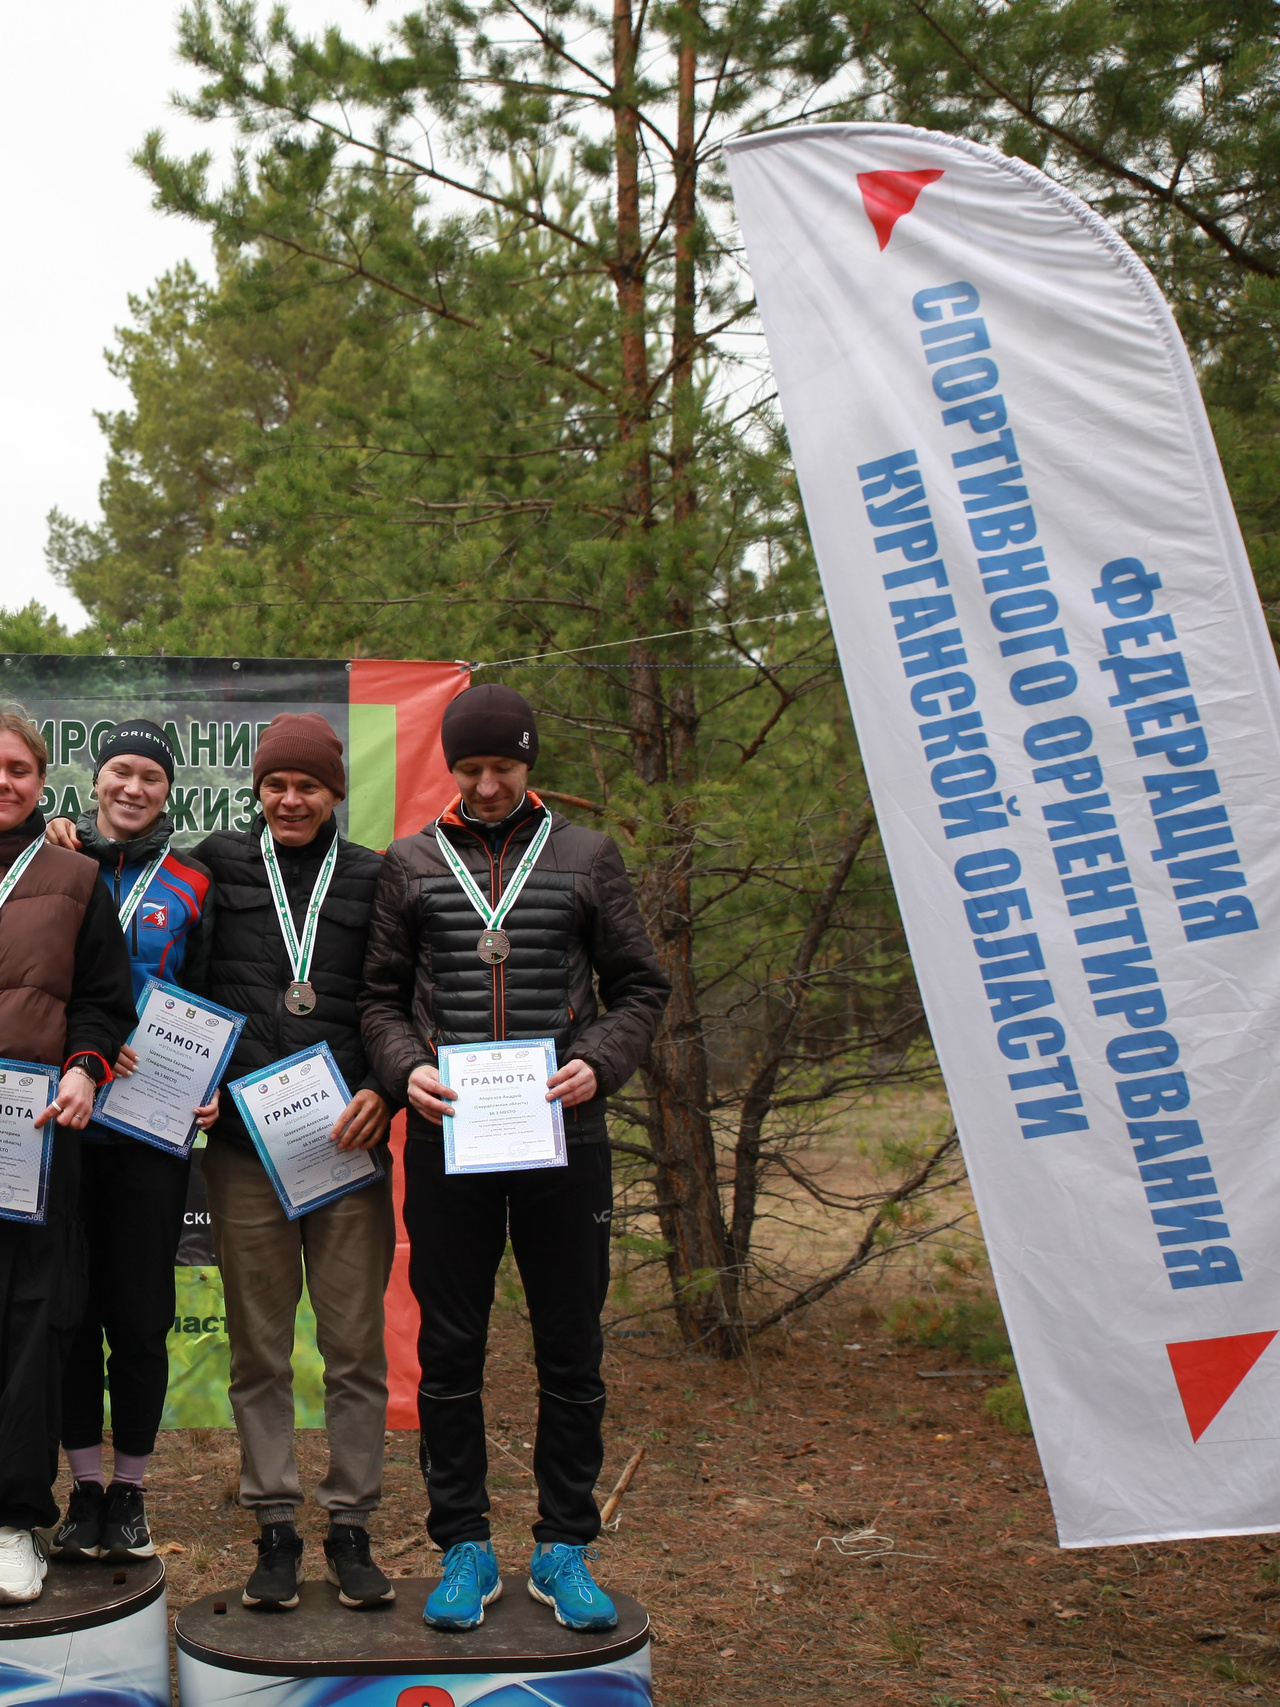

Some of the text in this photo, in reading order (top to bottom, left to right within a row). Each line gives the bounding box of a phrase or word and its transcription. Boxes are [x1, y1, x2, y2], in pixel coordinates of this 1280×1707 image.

[856, 448, 1090, 1140] КУРГАНСКОЙ ОБЛАСТИ
[912, 280, 1244, 1290] СПОРТИВНОГО ОРИЕНТИРОВАНИЯ
[1091, 557, 1260, 943] ФЕДЕРАЦИЯ
[147, 1023, 211, 1059] ГРАМОТА
[264, 1089, 330, 1125] ГРАМОТА
[461, 1073, 536, 1087] ГРАМОТА
